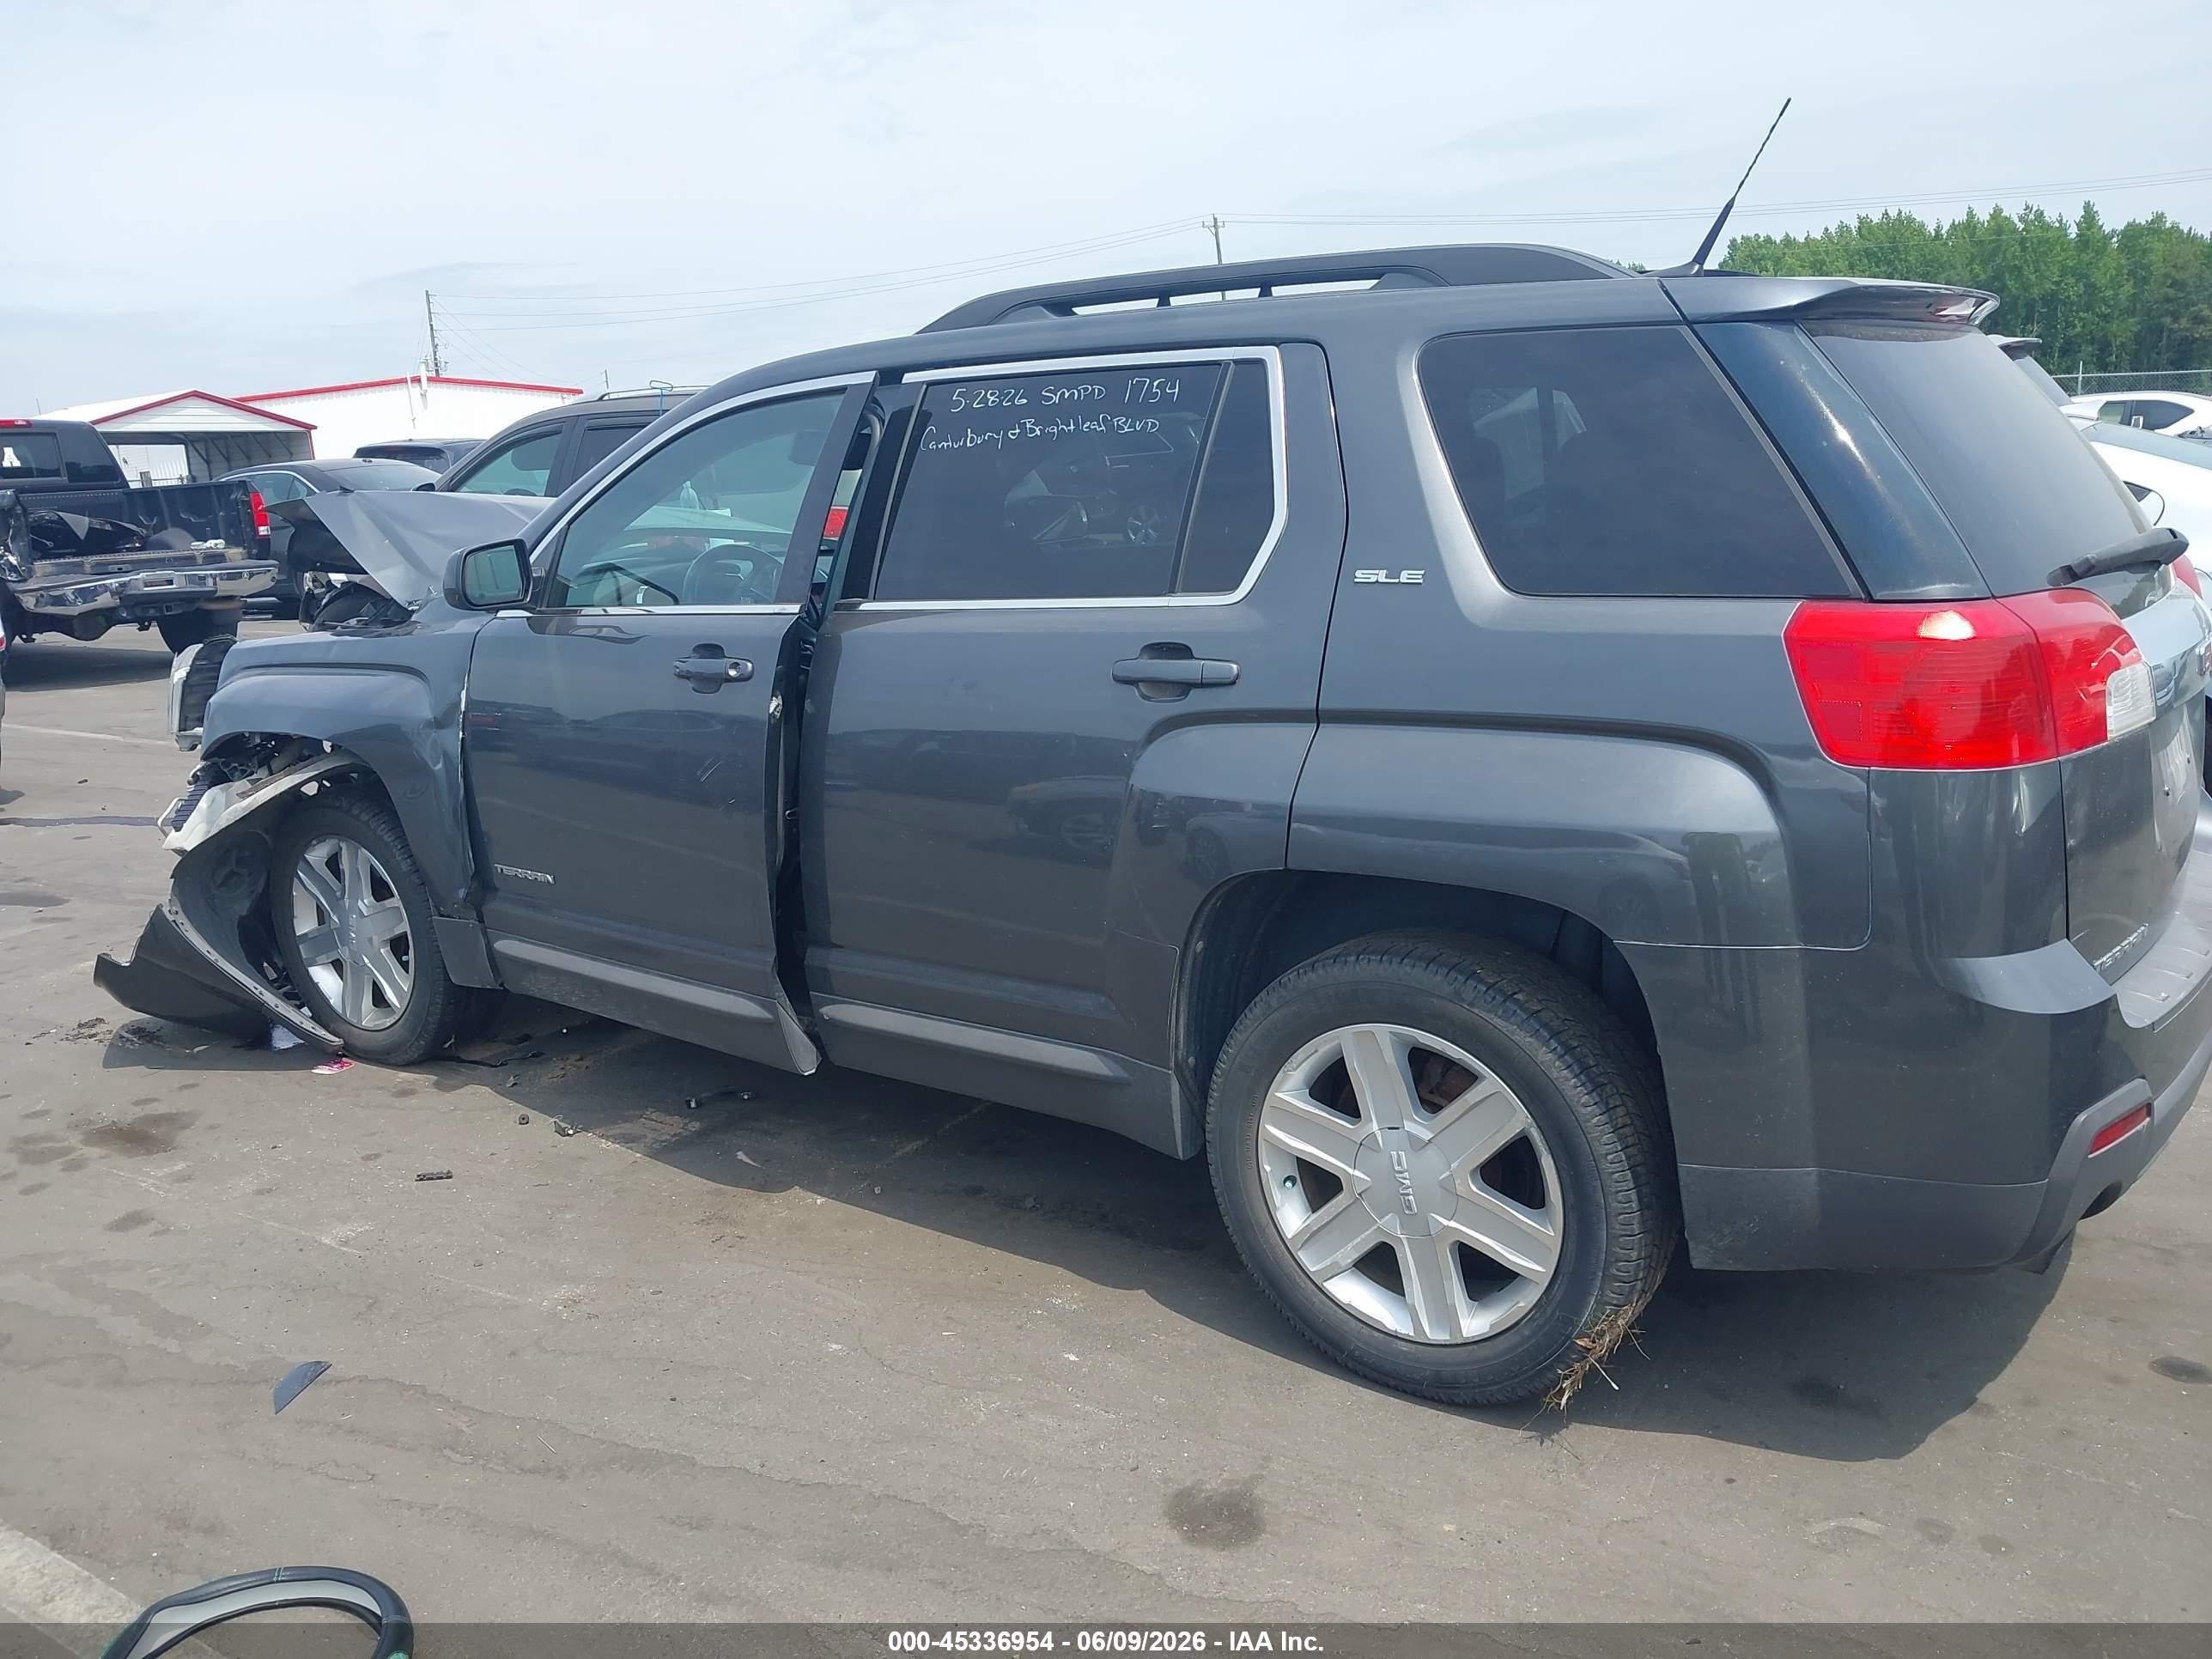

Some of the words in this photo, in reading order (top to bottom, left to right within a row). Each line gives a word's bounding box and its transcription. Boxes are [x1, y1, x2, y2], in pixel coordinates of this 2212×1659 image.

[1041, 385, 1107, 405] SMPD
[1124, 377, 1182, 404] 1754
[1113, 416, 1160, 434] BLVD
[1353, 569, 1425, 584] SLE
[494, 863, 556, 885] TERRAIN
[1390, 1151, 1418, 1215] GMC
